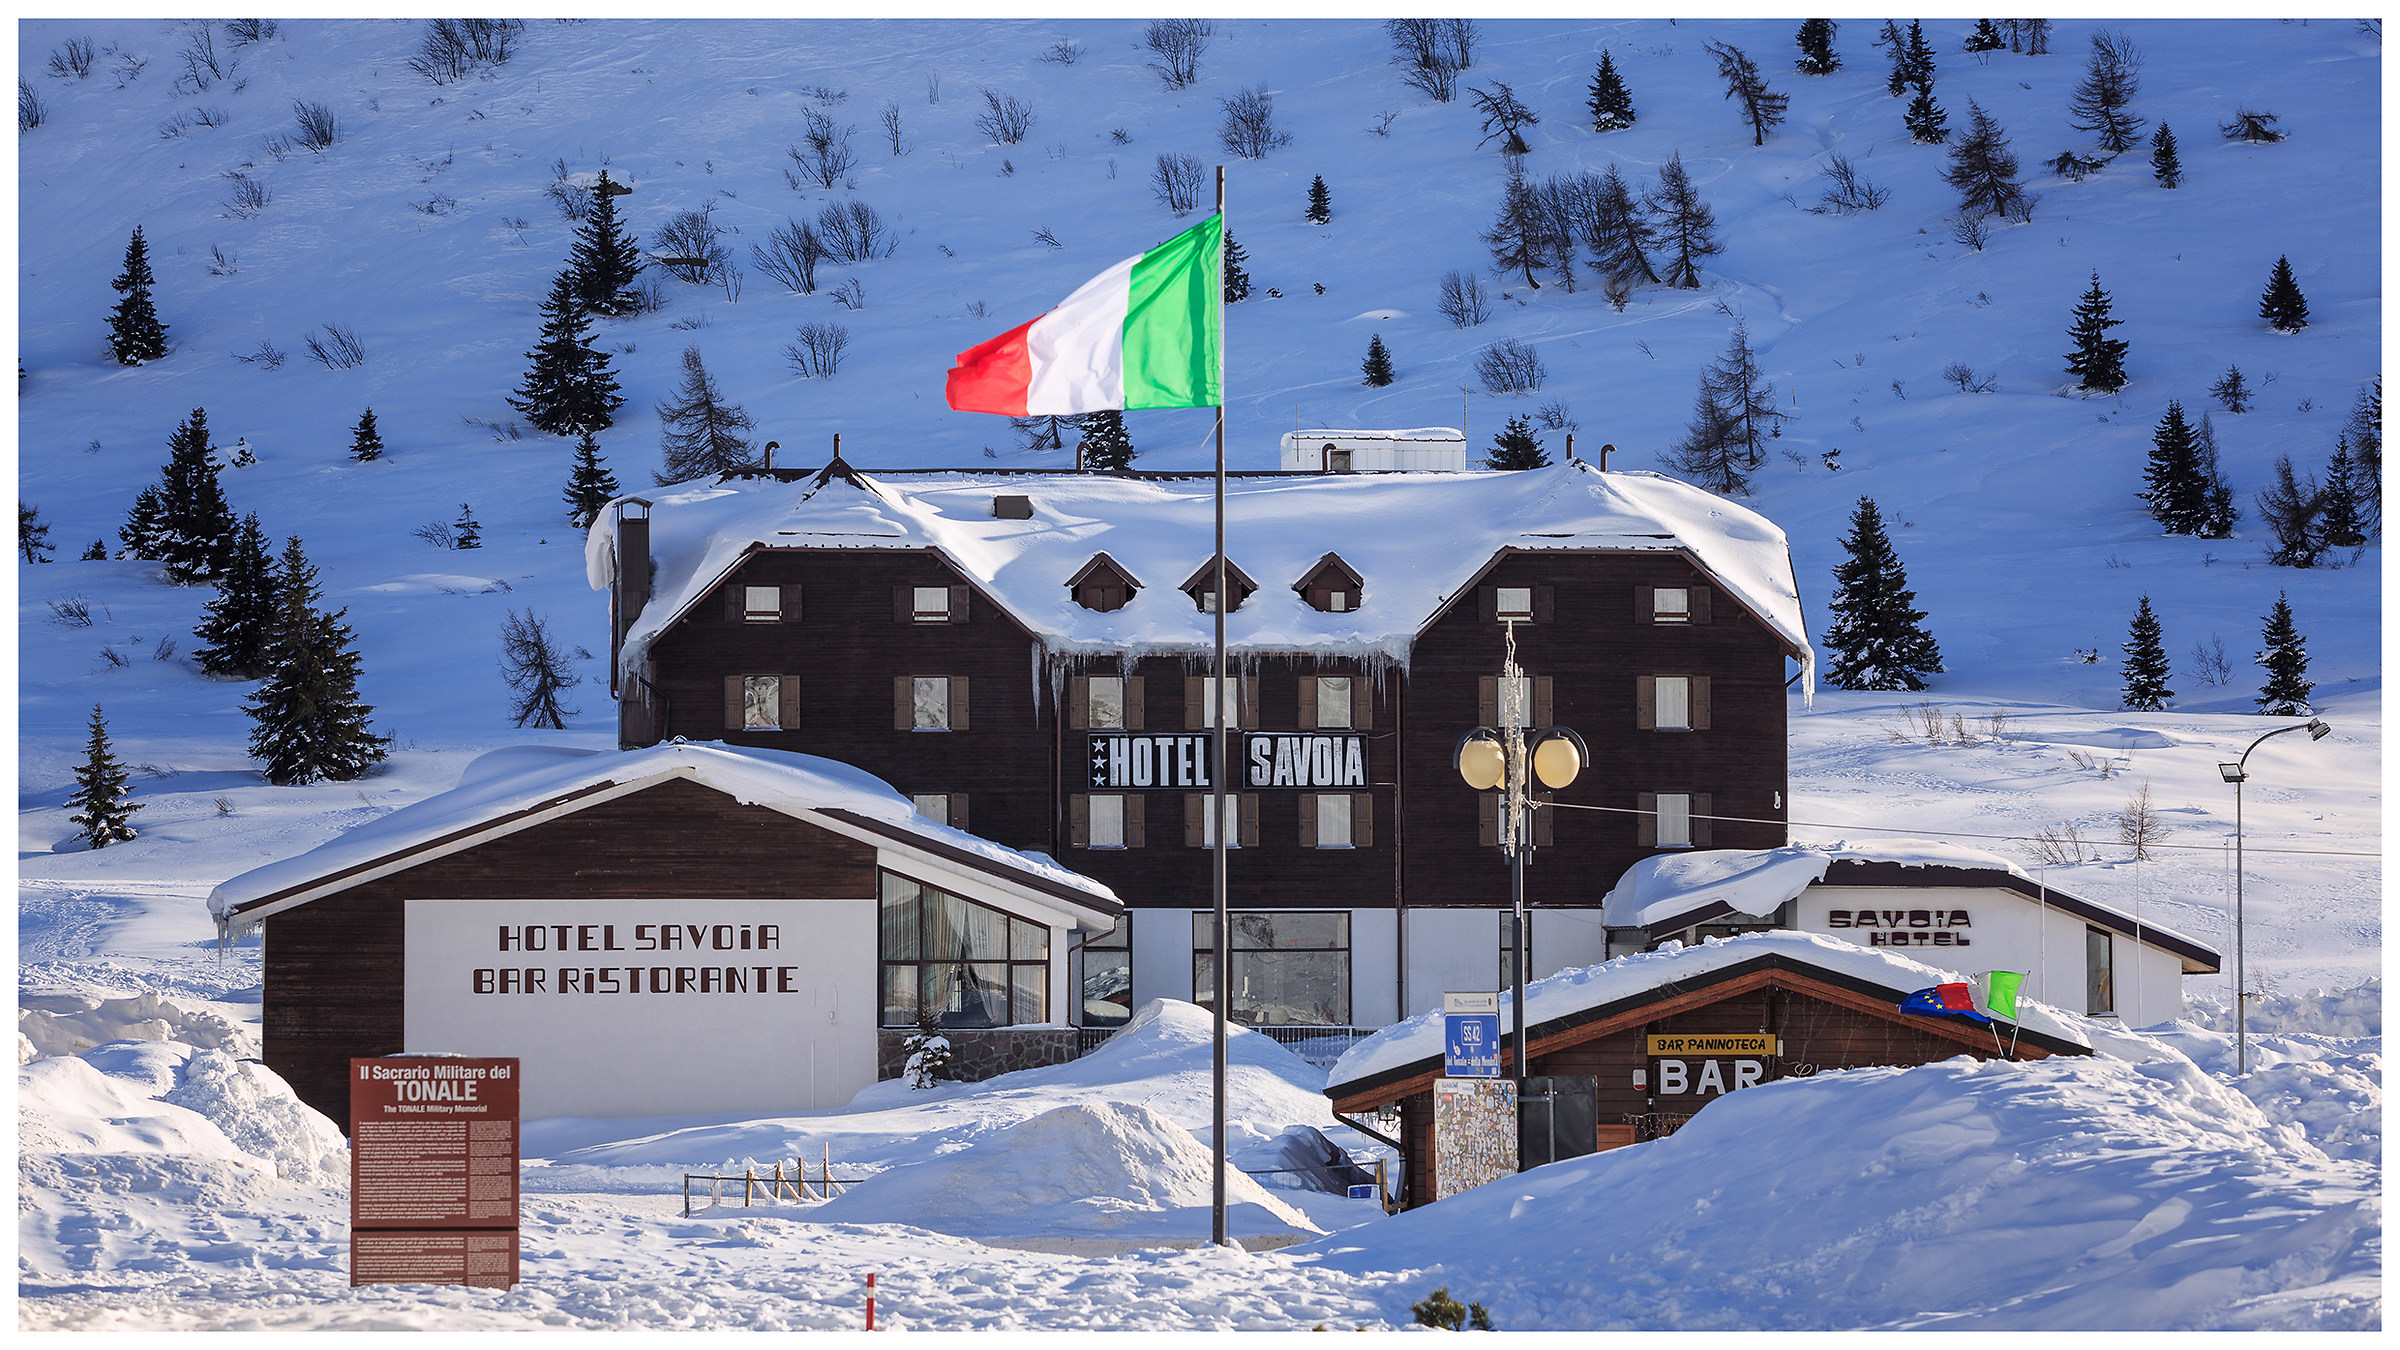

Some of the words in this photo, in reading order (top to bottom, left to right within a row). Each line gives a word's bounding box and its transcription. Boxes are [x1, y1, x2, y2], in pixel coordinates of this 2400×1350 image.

[1109, 736, 1210, 787] HOTEL
[1250, 736, 1365, 787] SAVOIA
[498, 924, 626, 952] HOTEL
[1870, 931, 1970, 947] HOTEL
[472, 967, 547, 994] BAR
[1463, 1025, 1472, 1042] SS
[1472, 1025, 1481, 1042] 42
[1657, 1038, 1683, 1052] BAR
[1687, 1038, 1766, 1051] PANINOTECA
[360, 1065, 369, 1080] Il
[372, 1065, 430, 1080] Sacrario
[433, 1065, 486, 1080] Militare
[489, 1065, 511, 1080] del
[1660, 1059, 1764, 1095] BAR
[393, 1080, 477, 1101] TONALE
[384, 1105, 397, 1113] The
[398, 1105, 425, 1113] TONALE
[426, 1105, 453, 1114] Military
[454, 1105, 488, 1113] Memorial
